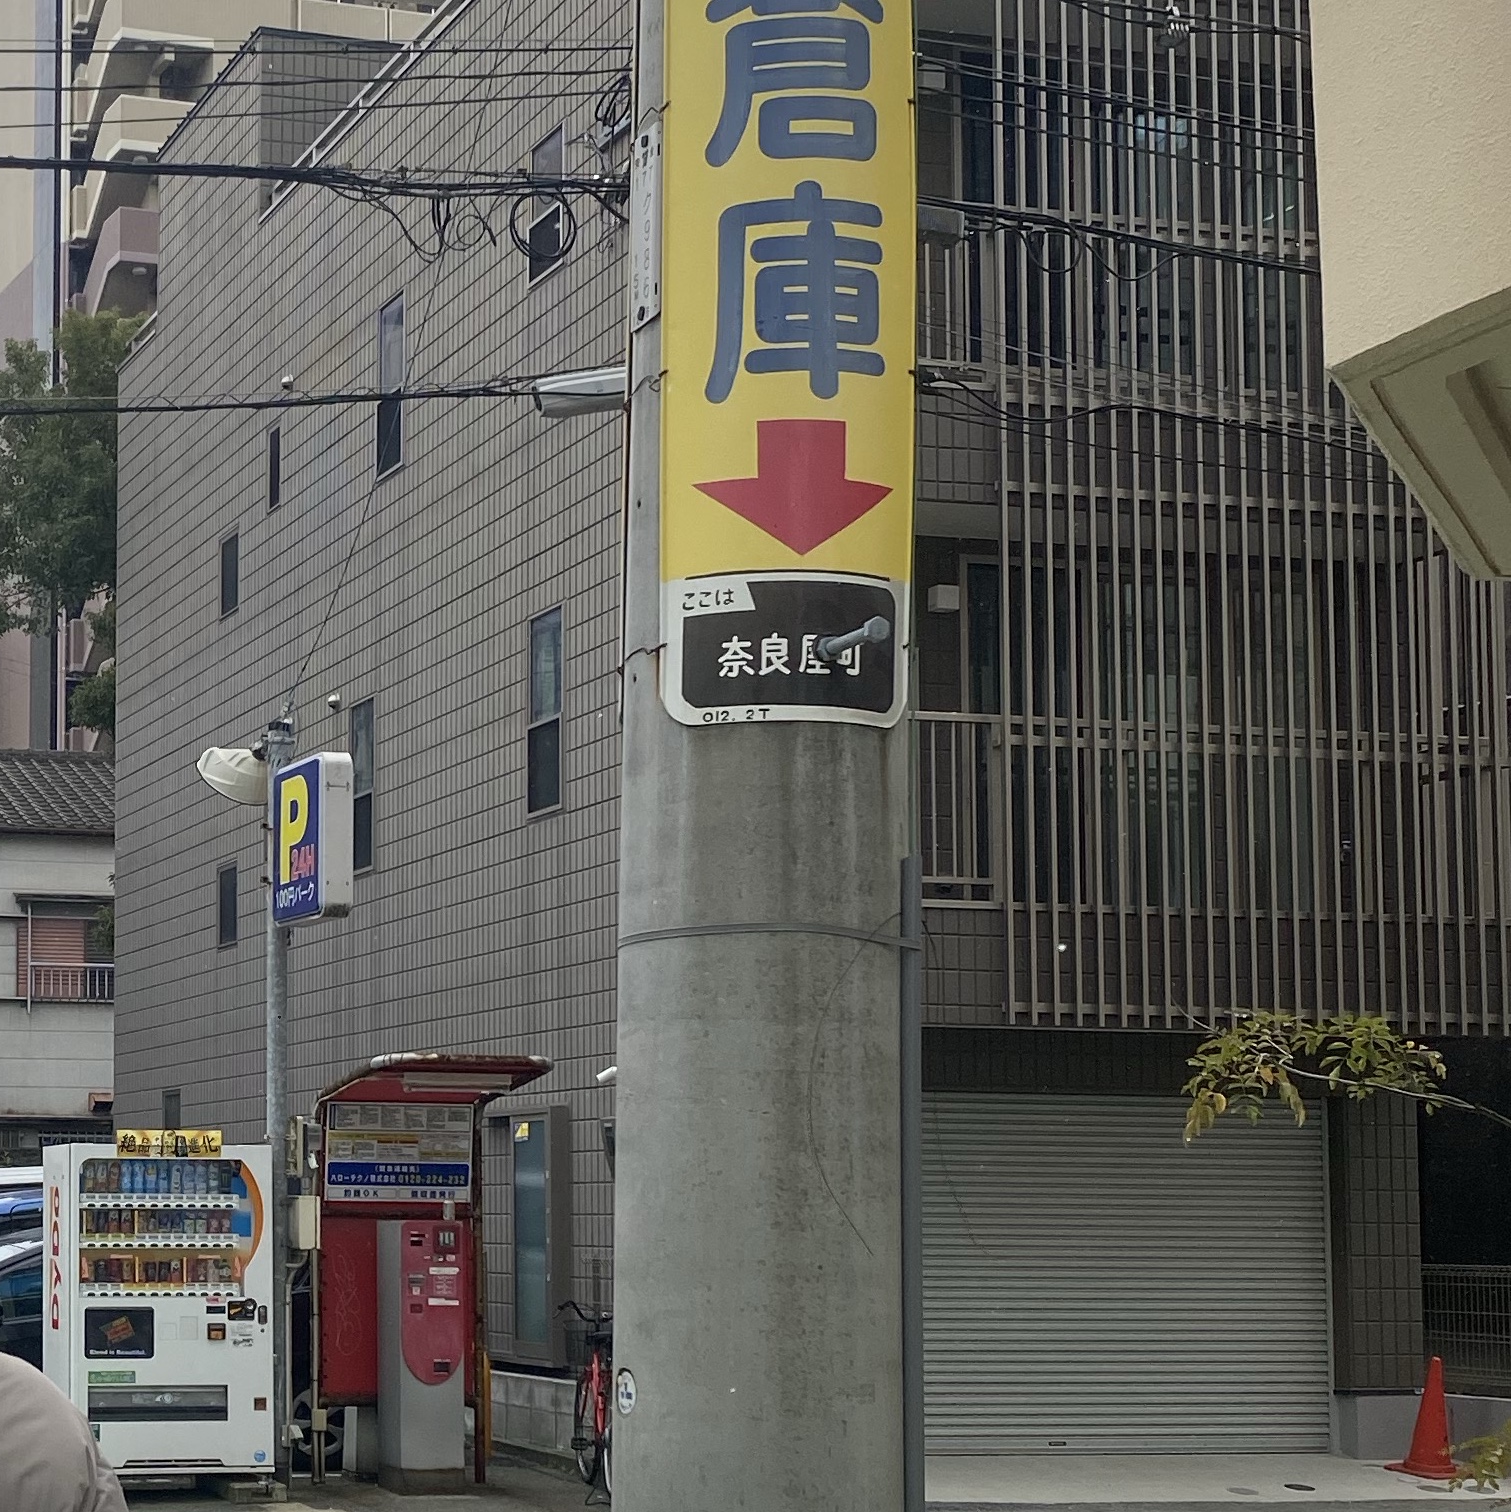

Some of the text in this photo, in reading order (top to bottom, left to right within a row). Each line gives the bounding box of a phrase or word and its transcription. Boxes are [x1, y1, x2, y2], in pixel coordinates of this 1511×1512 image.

[705, 0, 886, 404] 倉庫
[682, 588, 735, 611] ここは
[280, 774, 309, 886] P
[291, 843, 315, 882] 24H
[275, 880, 315, 909] 100円パーク
[120, 1133, 150, 1153] 絶品
